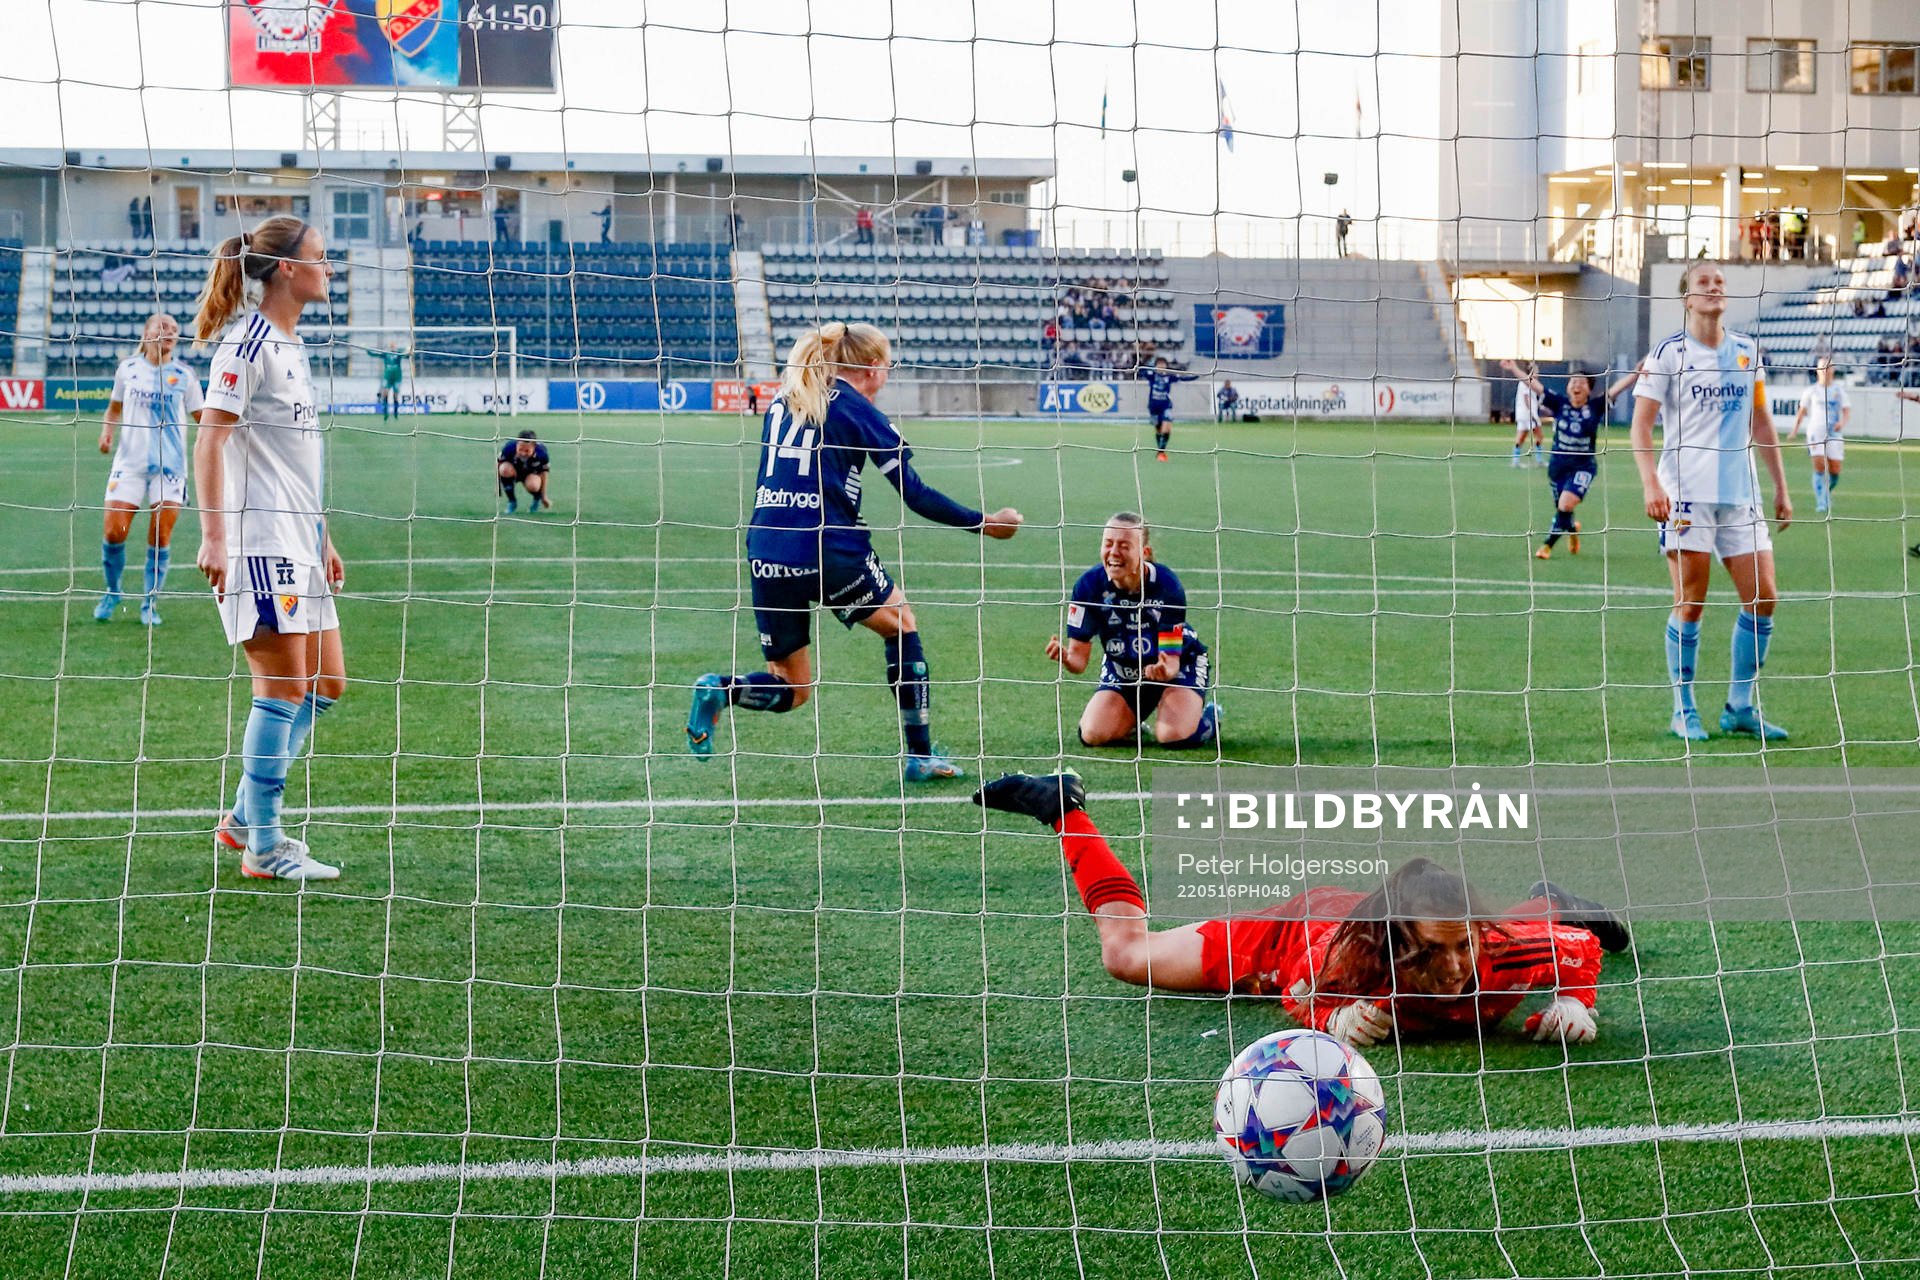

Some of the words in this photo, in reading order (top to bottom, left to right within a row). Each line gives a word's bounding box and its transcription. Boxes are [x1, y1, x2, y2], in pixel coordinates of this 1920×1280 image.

[467, 4, 546, 31] 61:50
[1692, 384, 1748, 399] Prioritet
[1237, 393, 1347, 413] stgötatidningen
[766, 402, 816, 478] 14
[764, 487, 820, 509] Botrygg
